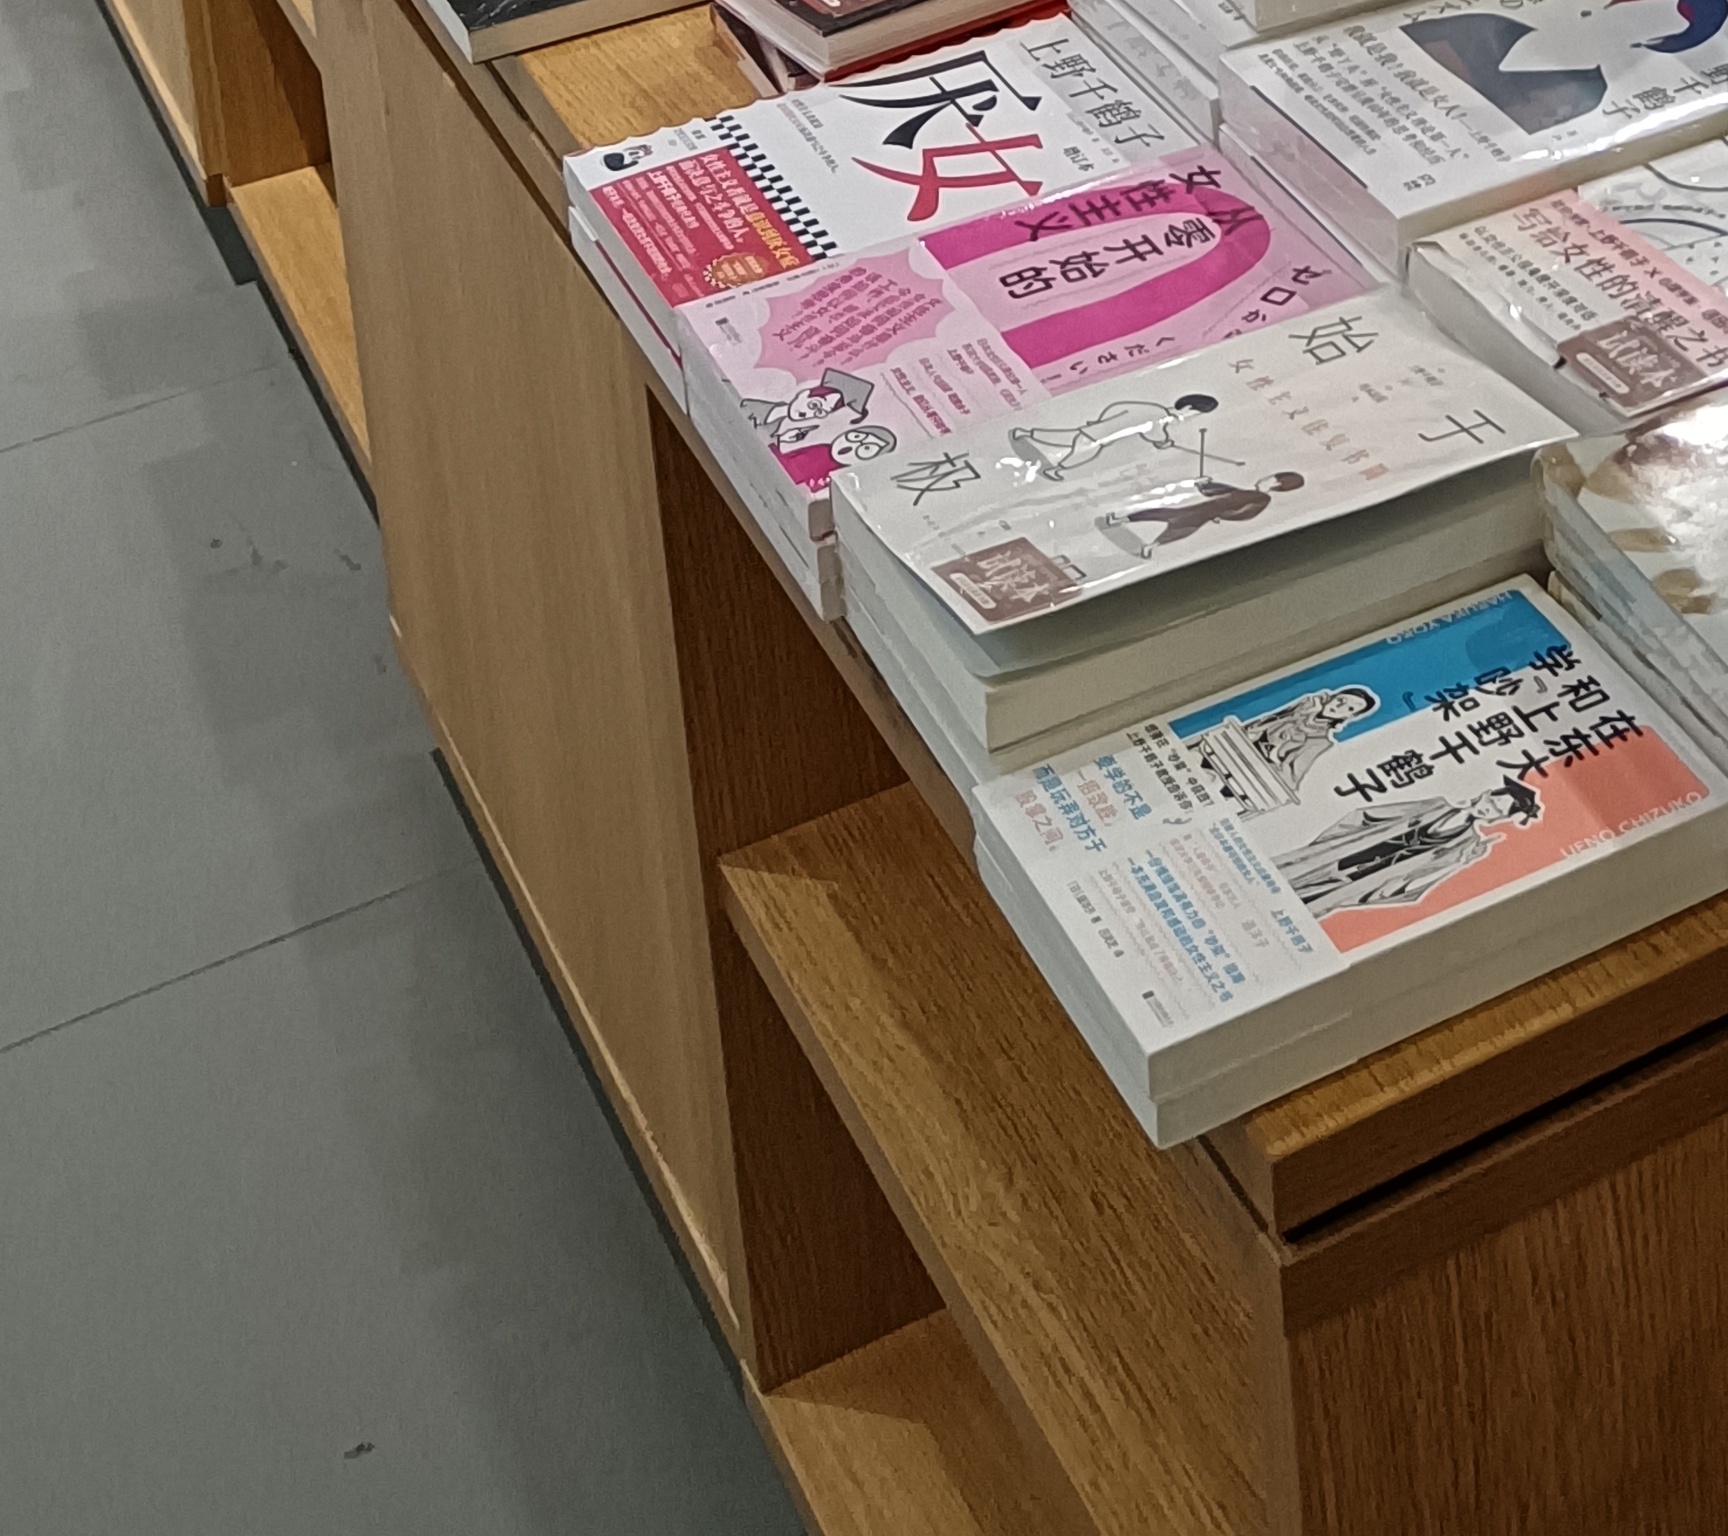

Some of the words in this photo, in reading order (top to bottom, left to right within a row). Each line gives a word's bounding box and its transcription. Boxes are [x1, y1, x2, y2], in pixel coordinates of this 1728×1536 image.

[1018, 37, 1167, 150] 上野千鹤子
[826, 50, 1044, 222] 厌女
[1012, 163, 1224, 244] 女性主义
[1289, 316, 1379, 365] 始
[1418, 409, 1506, 445] 于
[891, 453, 981, 507] 极
[1402, 645, 1583, 722] 学『吵架』
[1333, 674, 1610, 804] 和上野千鹤子
[1496, 710, 1643, 781] 在东大
[1031, 762, 1108, 857] 而是玩弄对方于
[1093, 752, 1154, 821] 要学的不是
[1614, 789, 1705, 834] CHIZUKO
